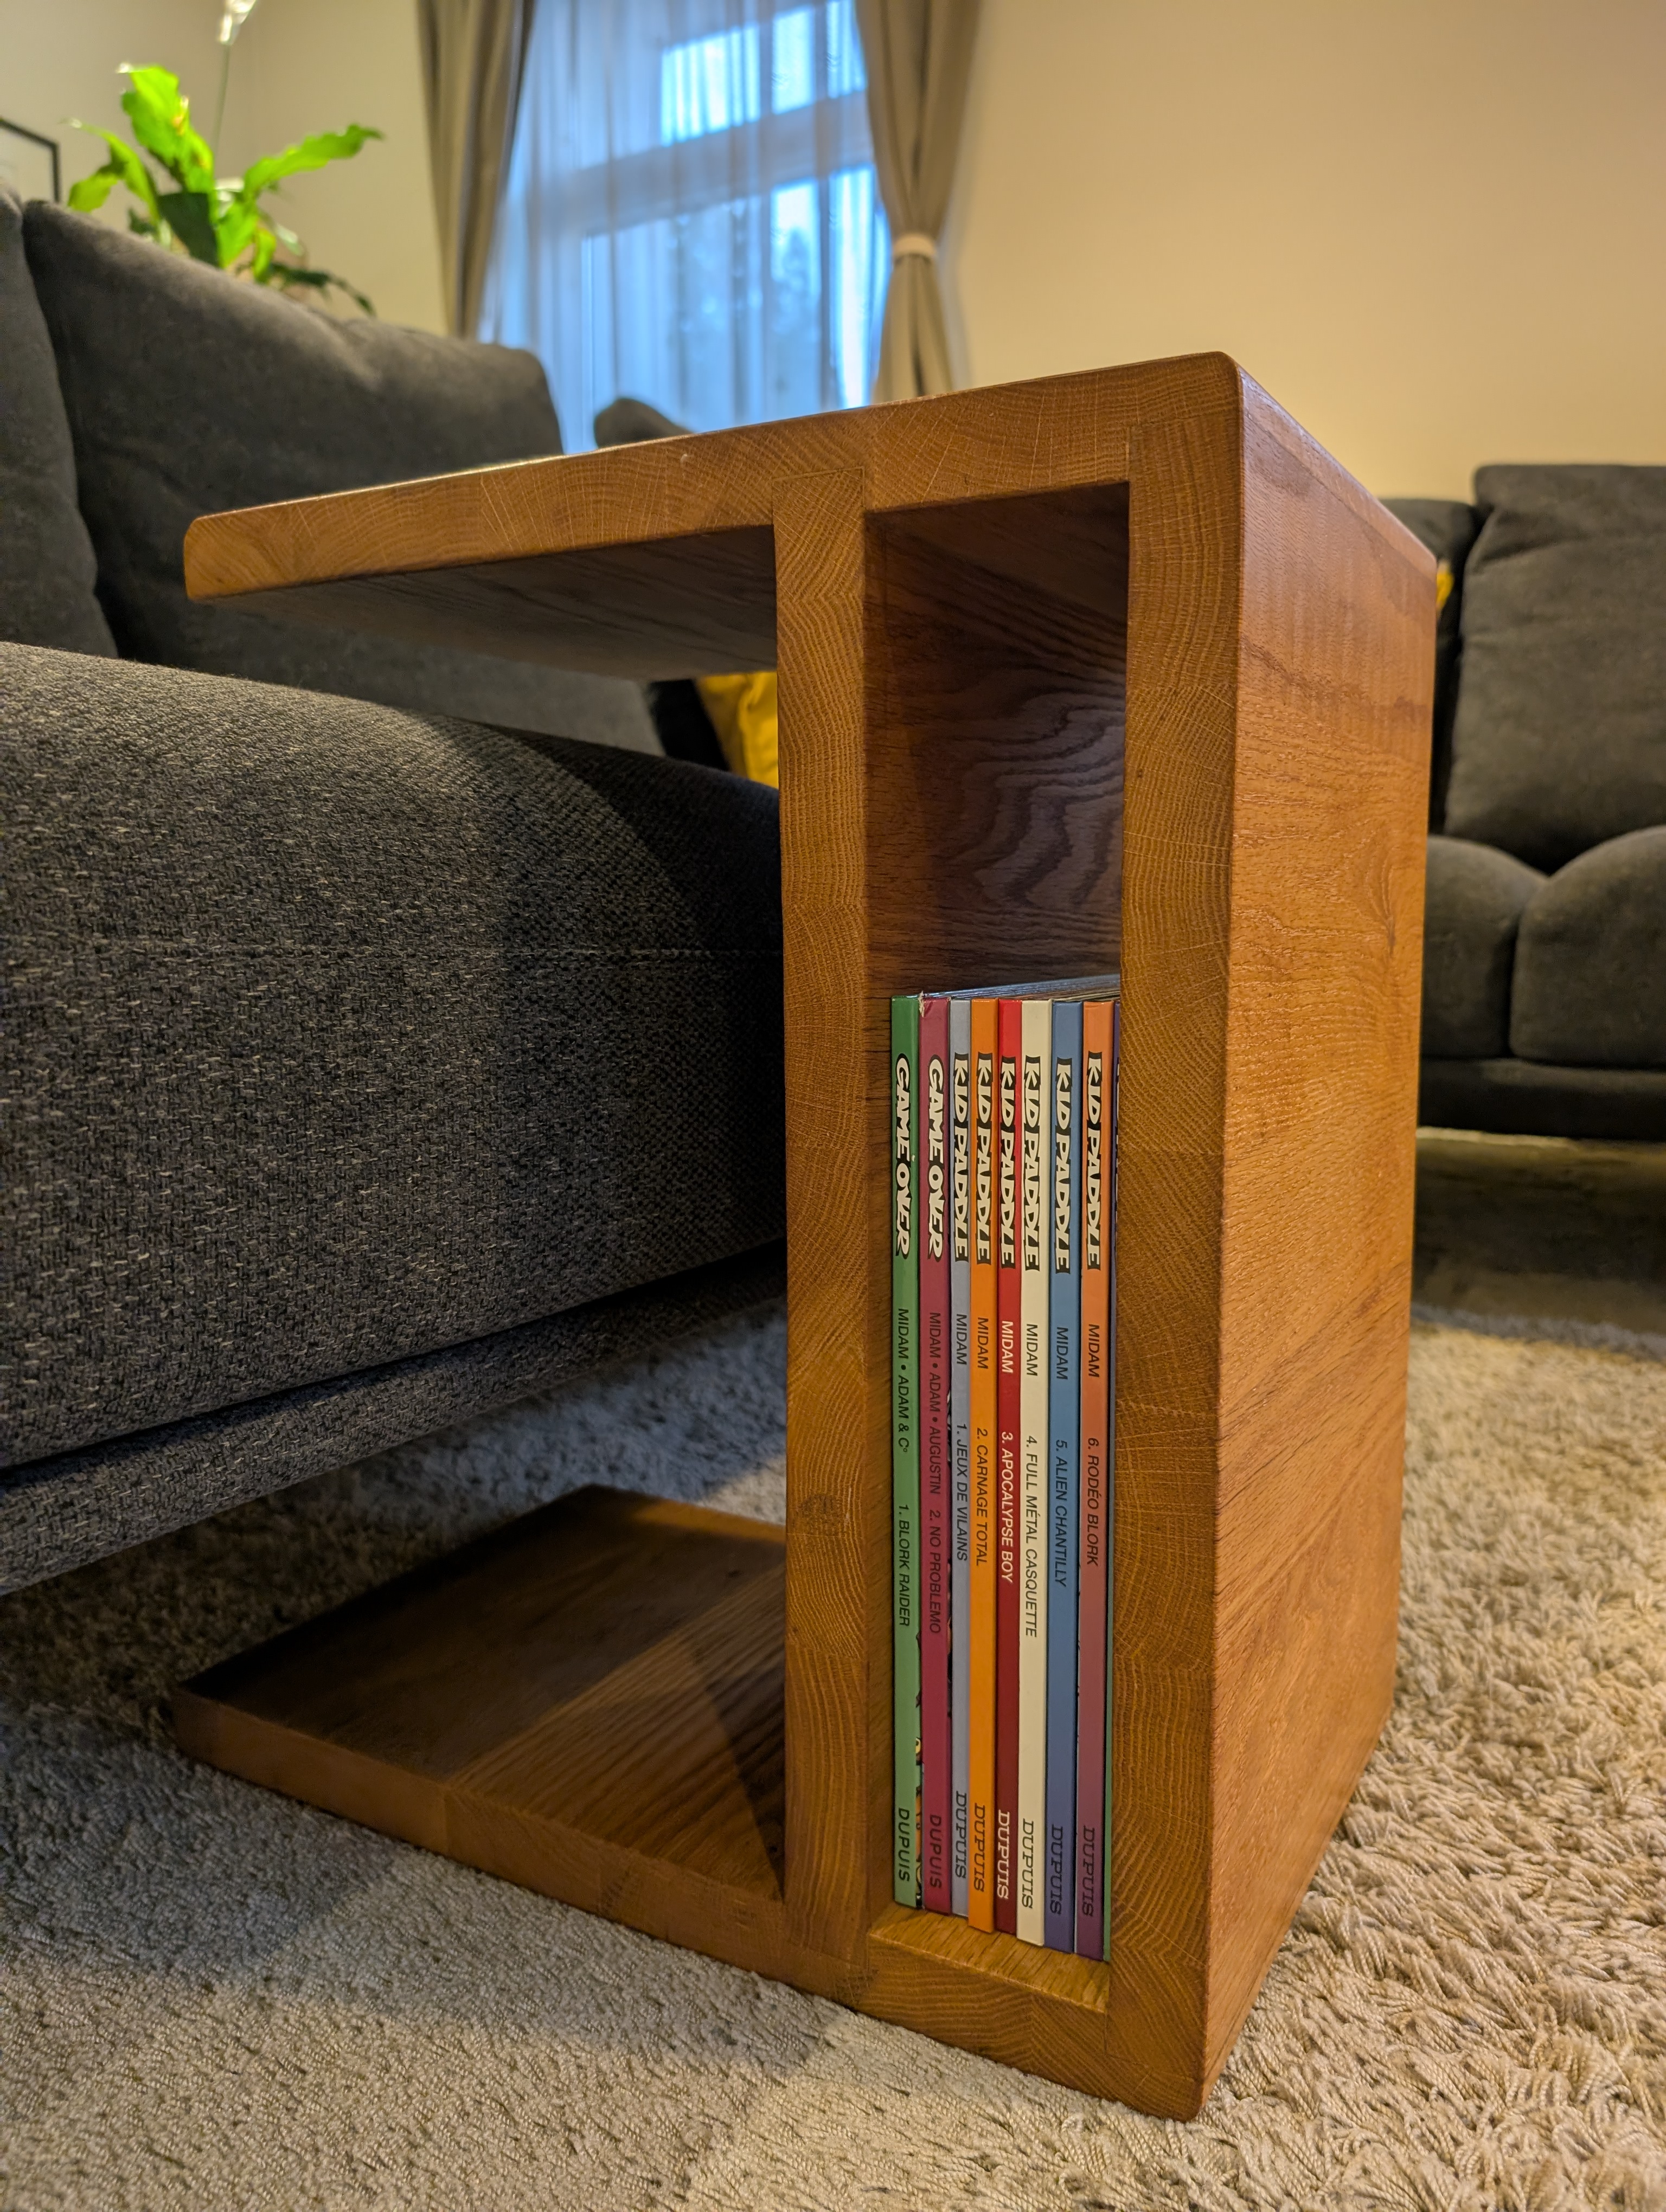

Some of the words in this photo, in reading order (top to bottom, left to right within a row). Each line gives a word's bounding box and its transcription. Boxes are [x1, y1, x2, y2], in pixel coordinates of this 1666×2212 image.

[895, 1053, 911, 1162] GAME
[928, 1054, 944, 1164] GAME
[954, 1052, 969, 1123] KID
[976, 1052, 992, 1123] KID
[1001, 1056, 1016, 1127] KID
[1022, 1055, 1041, 1128] KID
[1055, 1057, 1072, 1130] KID
[1087, 1051, 1102, 1124] KID
[895, 1162, 911, 1259] OVER
[928, 1164, 944, 1262] OVER
[954, 1127, 969, 1262] PADDLE
[976, 1127, 992, 1265] PADDLE
[1001, 1132, 1016, 1269] PADDLE
[1022, 1132, 1041, 1271] PADDLE
[1055, 1134, 1072, 1274] PADDLE
[1087, 1129, 1102, 1270] PADDLE
[898, 1308, 909, 1359] MIDAM
[930, 1312, 941, 1358] MIDAM
[956, 1314, 967, 1365] MIDAM
[977, 1317, 989, 1369] MIDAM
[1002, 1321, 1013, 1374] MIDAM
[1026, 1323, 1038, 1376] MIDAM
[1056, 1327, 1069, 1380] MIDAM
[1088, 1323, 1100, 1378] MIDAM
[898, 1375, 909, 1419] ADAM
[930, 1372, 941, 1412] ADAM
[898, 1423, 909, 1432] &
[957, 1423, 966, 1435] 1.
[977, 1427, 988, 1440] 2.
[1002, 1431, 1013, 1444] 3.
[1026, 1435, 1037, 1448] 4.
[1056, 1439, 1068, 1451] 5.
[1088, 1437, 1099, 1450] 6.
[929, 1425, 941, 1495] AUGUSTIN
[957, 1439, 967, 1477] JEUX
[976, 1444, 988, 1518] CARNAGE
[1026, 1453, 1037, 1490] FULL
[1055, 1456, 1067, 1501] ALIEN
[1087, 1455, 1101, 1509] RODÉO
[899, 1504, 909, 1515] 1.
[930, 1509, 941, 1521] 2.
[957, 1482, 967, 1502] DE
[1001, 1448, 1014, 1547] APOCALYPSE
[1026, 1495, 1040, 1544] MÉTAL
[899, 1520, 910, 1570] BLORK
[930, 1526, 941, 1547] NO
[957, 1506, 967, 1562] VILAINS
[976, 1522, 988, 1566] TOTAL
[1055, 1506, 1067, 1587] CHANTILLY
[1087, 1515, 1099, 1567] BLORK
[930, 1552, 941, 1634] PROBLEMO
[1001, 1551, 1013, 1583] BOY
[1025, 1548, 1037, 1638] CASQUETTE
[899, 1573, 910, 1627] RAIDER
[898, 1807, 910, 1882] DUPUIS
[930, 1814, 942, 1889] DUPUIS
[956, 1791, 967, 1879] DUPUIS
[974, 1802, 985, 1892] DUPUIS
[997, 1809, 1010, 1900] DUPUIS
[1022, 1818, 1034, 1909] DUPUIS
[1050, 1824, 1063, 1915] DUPUIS
[1082, 1825, 1095, 1917] DUPUIS
